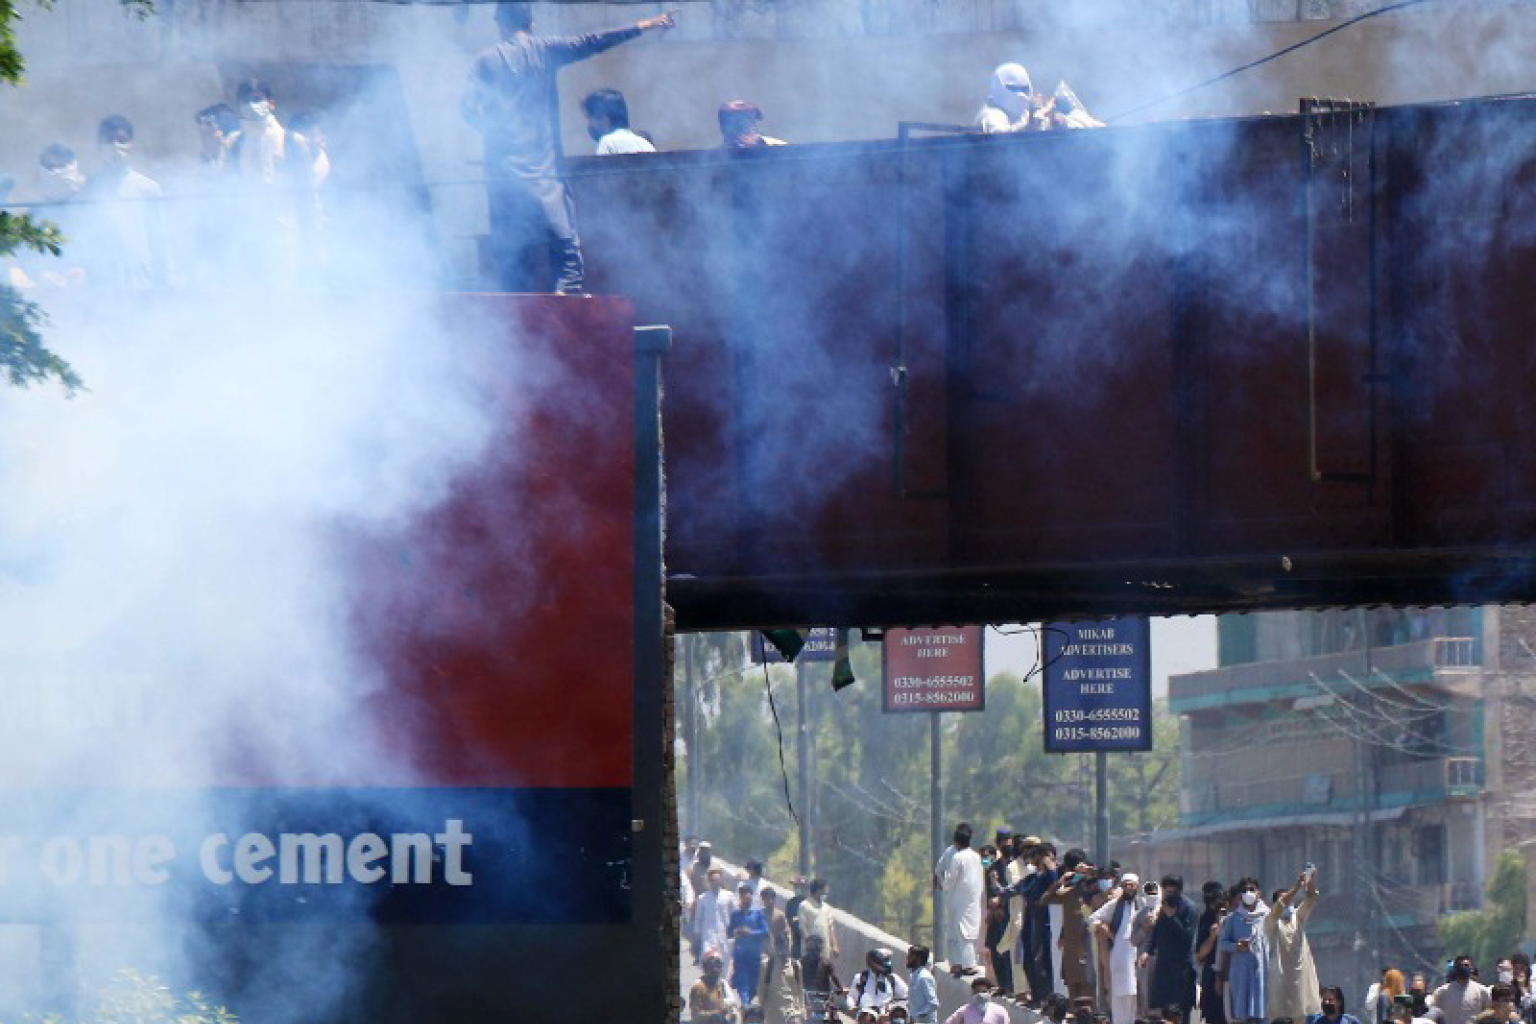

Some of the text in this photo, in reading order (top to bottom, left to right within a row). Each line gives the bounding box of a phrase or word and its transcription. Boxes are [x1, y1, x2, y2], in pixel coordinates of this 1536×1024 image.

[902, 634, 967, 646] ADVERTISE
[918, 648, 951, 658] HERE
[1063, 668, 1132, 680] ADVERTISE
[1080, 683, 1115, 694] HERE
[1055, 708, 1140, 722] 0330-6555502
[40, 832, 175, 886] one
[201, 819, 473, 886] cement
